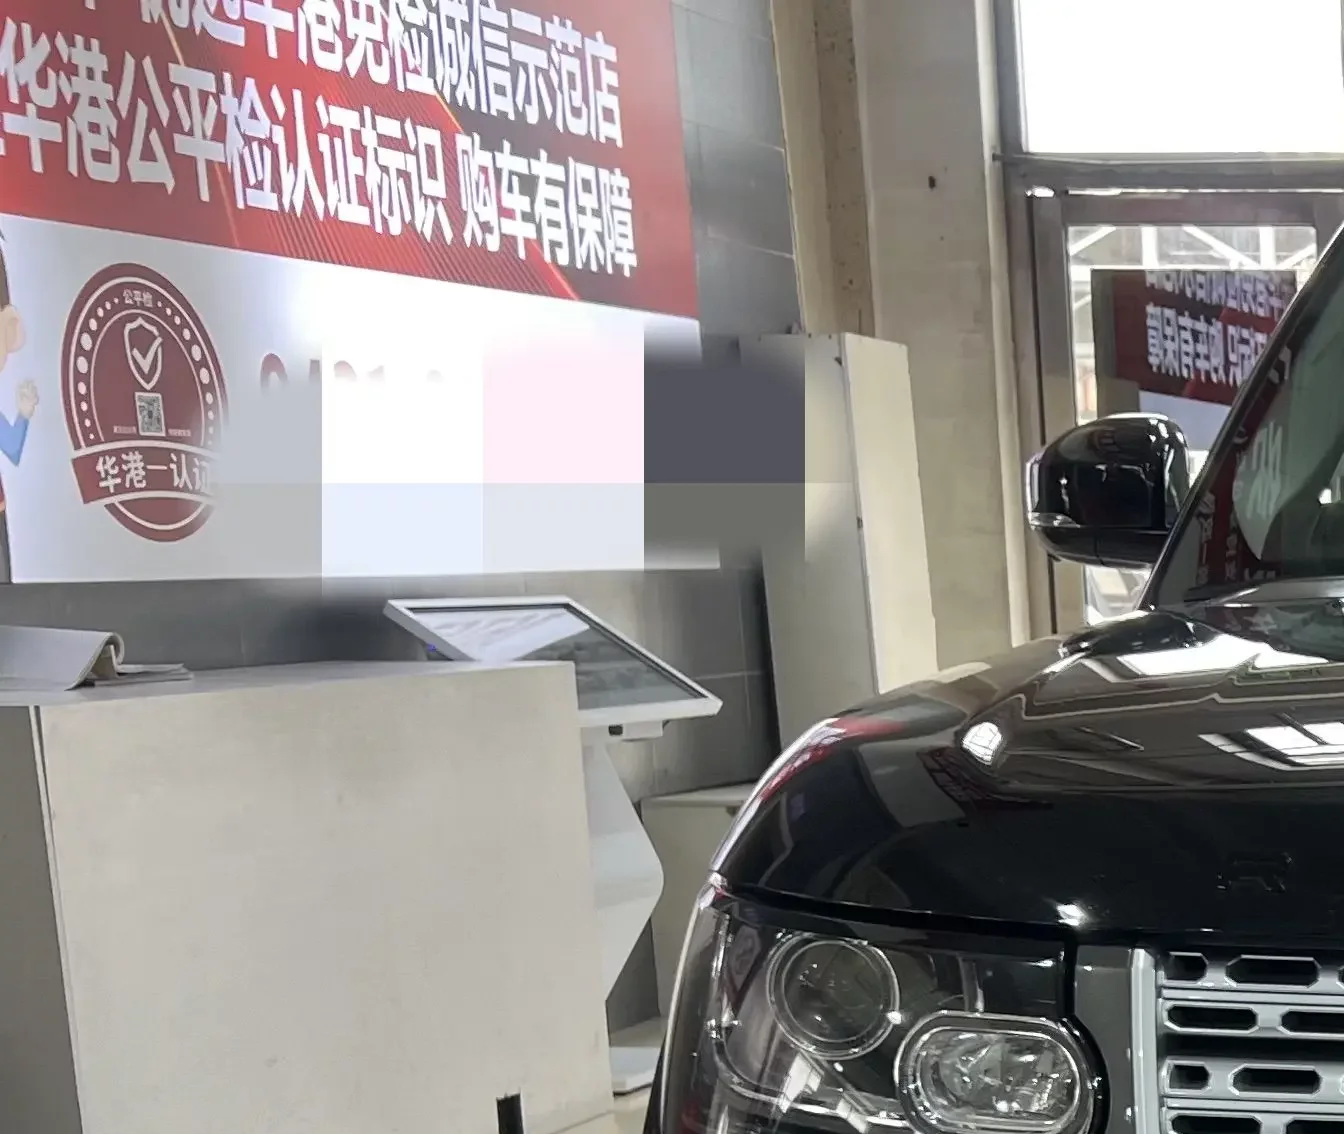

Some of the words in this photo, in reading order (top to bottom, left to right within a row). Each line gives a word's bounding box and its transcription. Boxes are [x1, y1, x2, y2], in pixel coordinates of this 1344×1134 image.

[0, 16, 453, 247] 华港公平检认证标识
[455, 131, 638, 277] 购车有保障
[82, 0, 623, 148] 港免检诚信示范店
